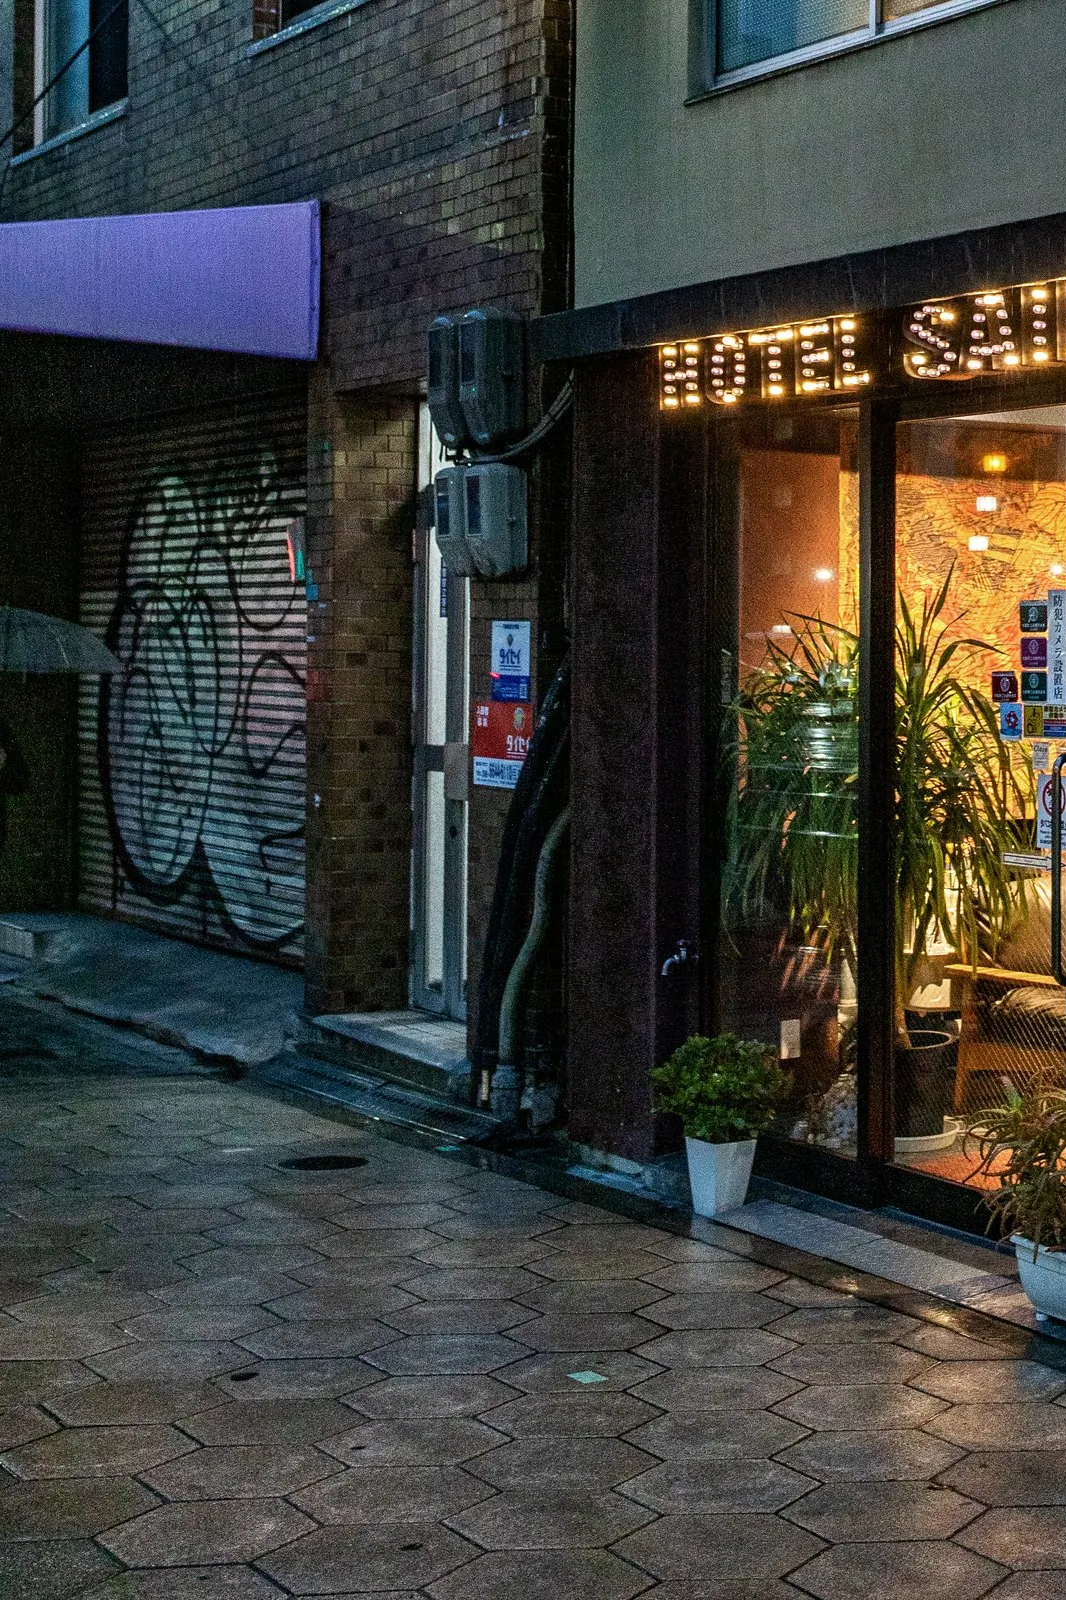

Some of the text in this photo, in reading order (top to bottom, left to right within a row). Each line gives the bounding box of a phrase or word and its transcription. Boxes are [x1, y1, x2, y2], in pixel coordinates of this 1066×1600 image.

[660, 314, 870, 410] HOTEL
[1052, 594, 1064, 700] 防犯カメラ設置店
